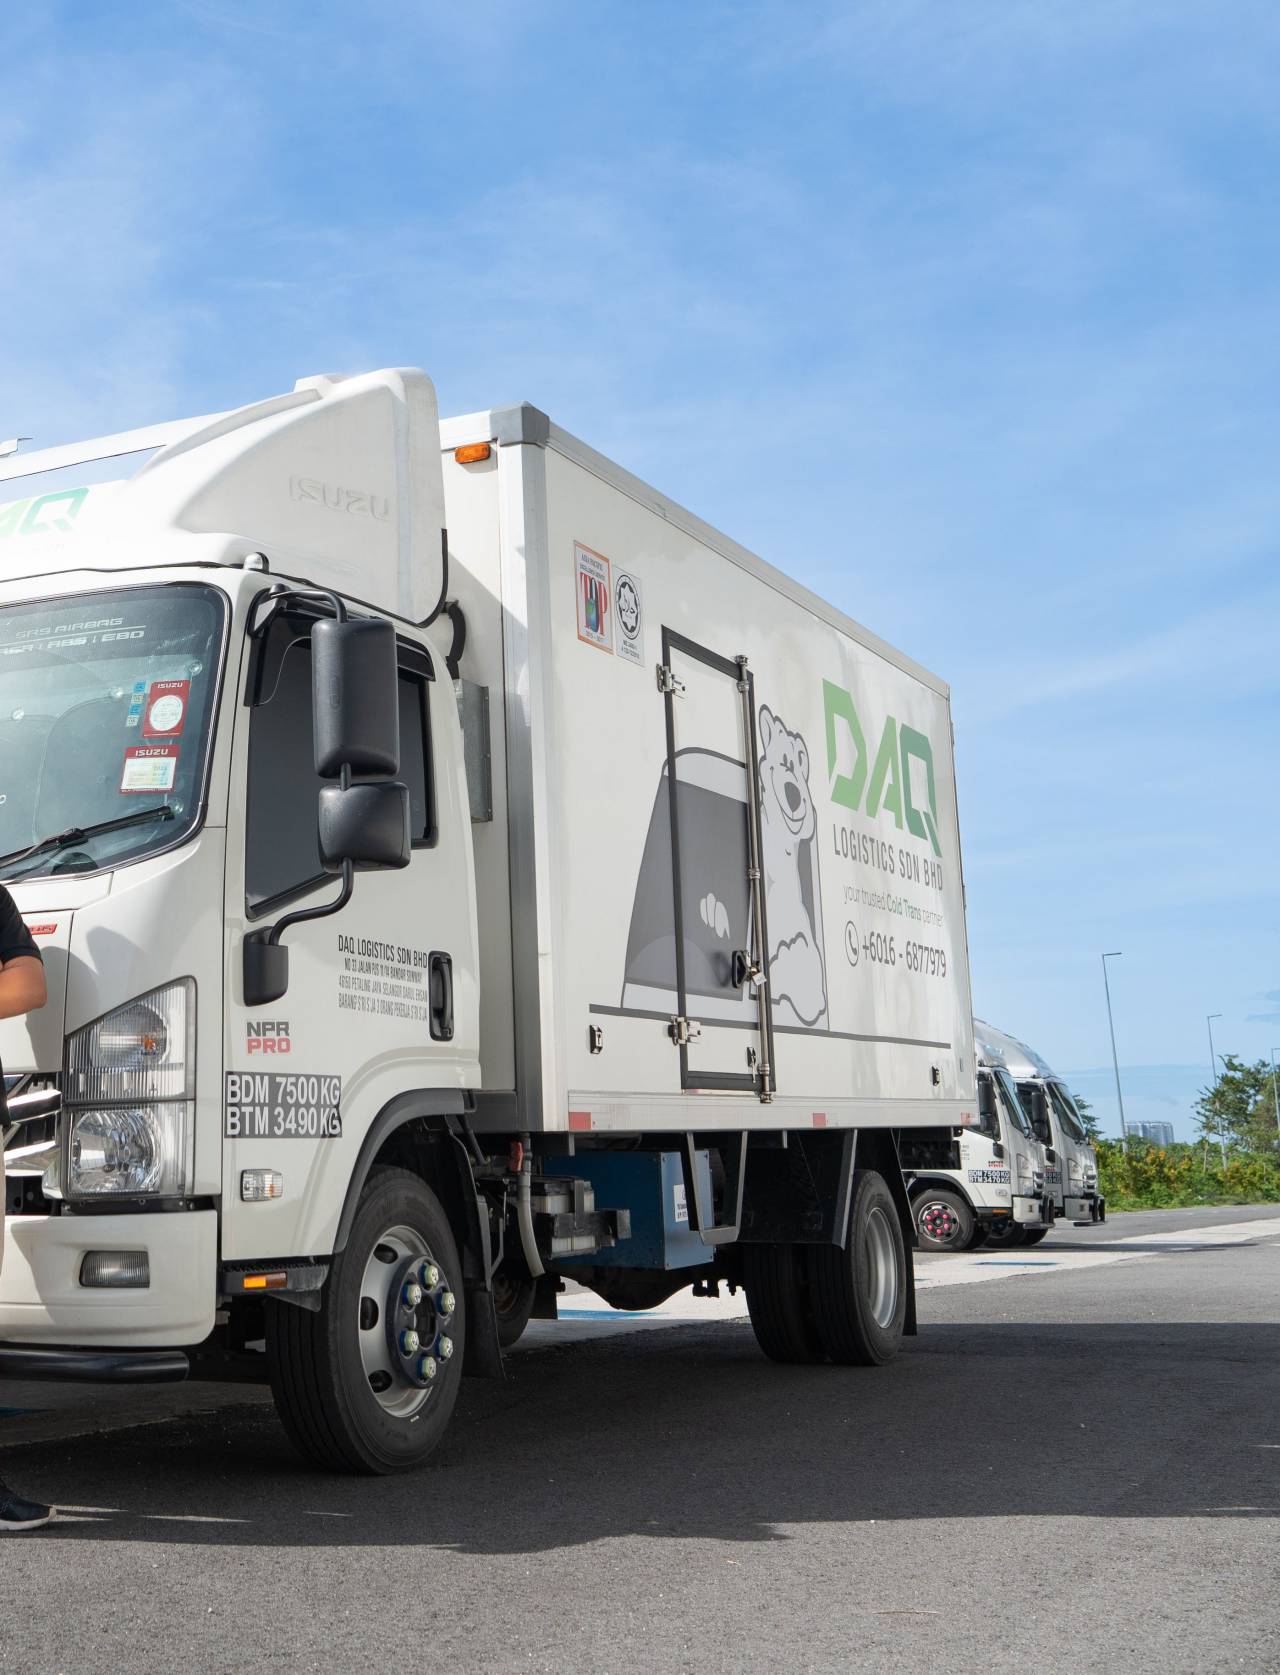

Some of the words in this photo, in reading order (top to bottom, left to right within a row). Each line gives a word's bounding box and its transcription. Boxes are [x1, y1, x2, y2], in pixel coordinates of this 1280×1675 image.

[289, 475, 389, 520] ISUZU
[54, 617, 124, 633] AIRBAG
[101, 630, 145, 642] EBD
[135, 748, 169, 757] ISUZU
[822, 678, 943, 858] DAQ
[833, 824, 895, 874] LOGISTICS
[899, 849, 920, 884] SDN
[924, 858, 943, 891] BHD
[844, 885, 861, 904] your
[862, 887, 886, 910] trusted
[887, 893, 903, 916] Cold
[904, 899, 921, 921] Trans
[338, 934, 354, 955] DAQ
[358, 938, 395, 962] LOGISTICS
[398, 946, 411, 966] SDN
[414, 950, 427, 968] BHD
[862, 931, 896, 966] +6016
[906, 940, 947, 978] 6877979
[247, 1021, 290, 1037] NPR
[247, 1038, 291, 1054] PRO
[227, 1075, 269, 1104] BDM
[276, 1076, 318, 1104] 7500
[321, 1078, 340, 1105] KG
[226, 1106, 269, 1135] BTM
[274, 1106, 318, 1135] 3490
[320, 1107, 340, 1135] KG
